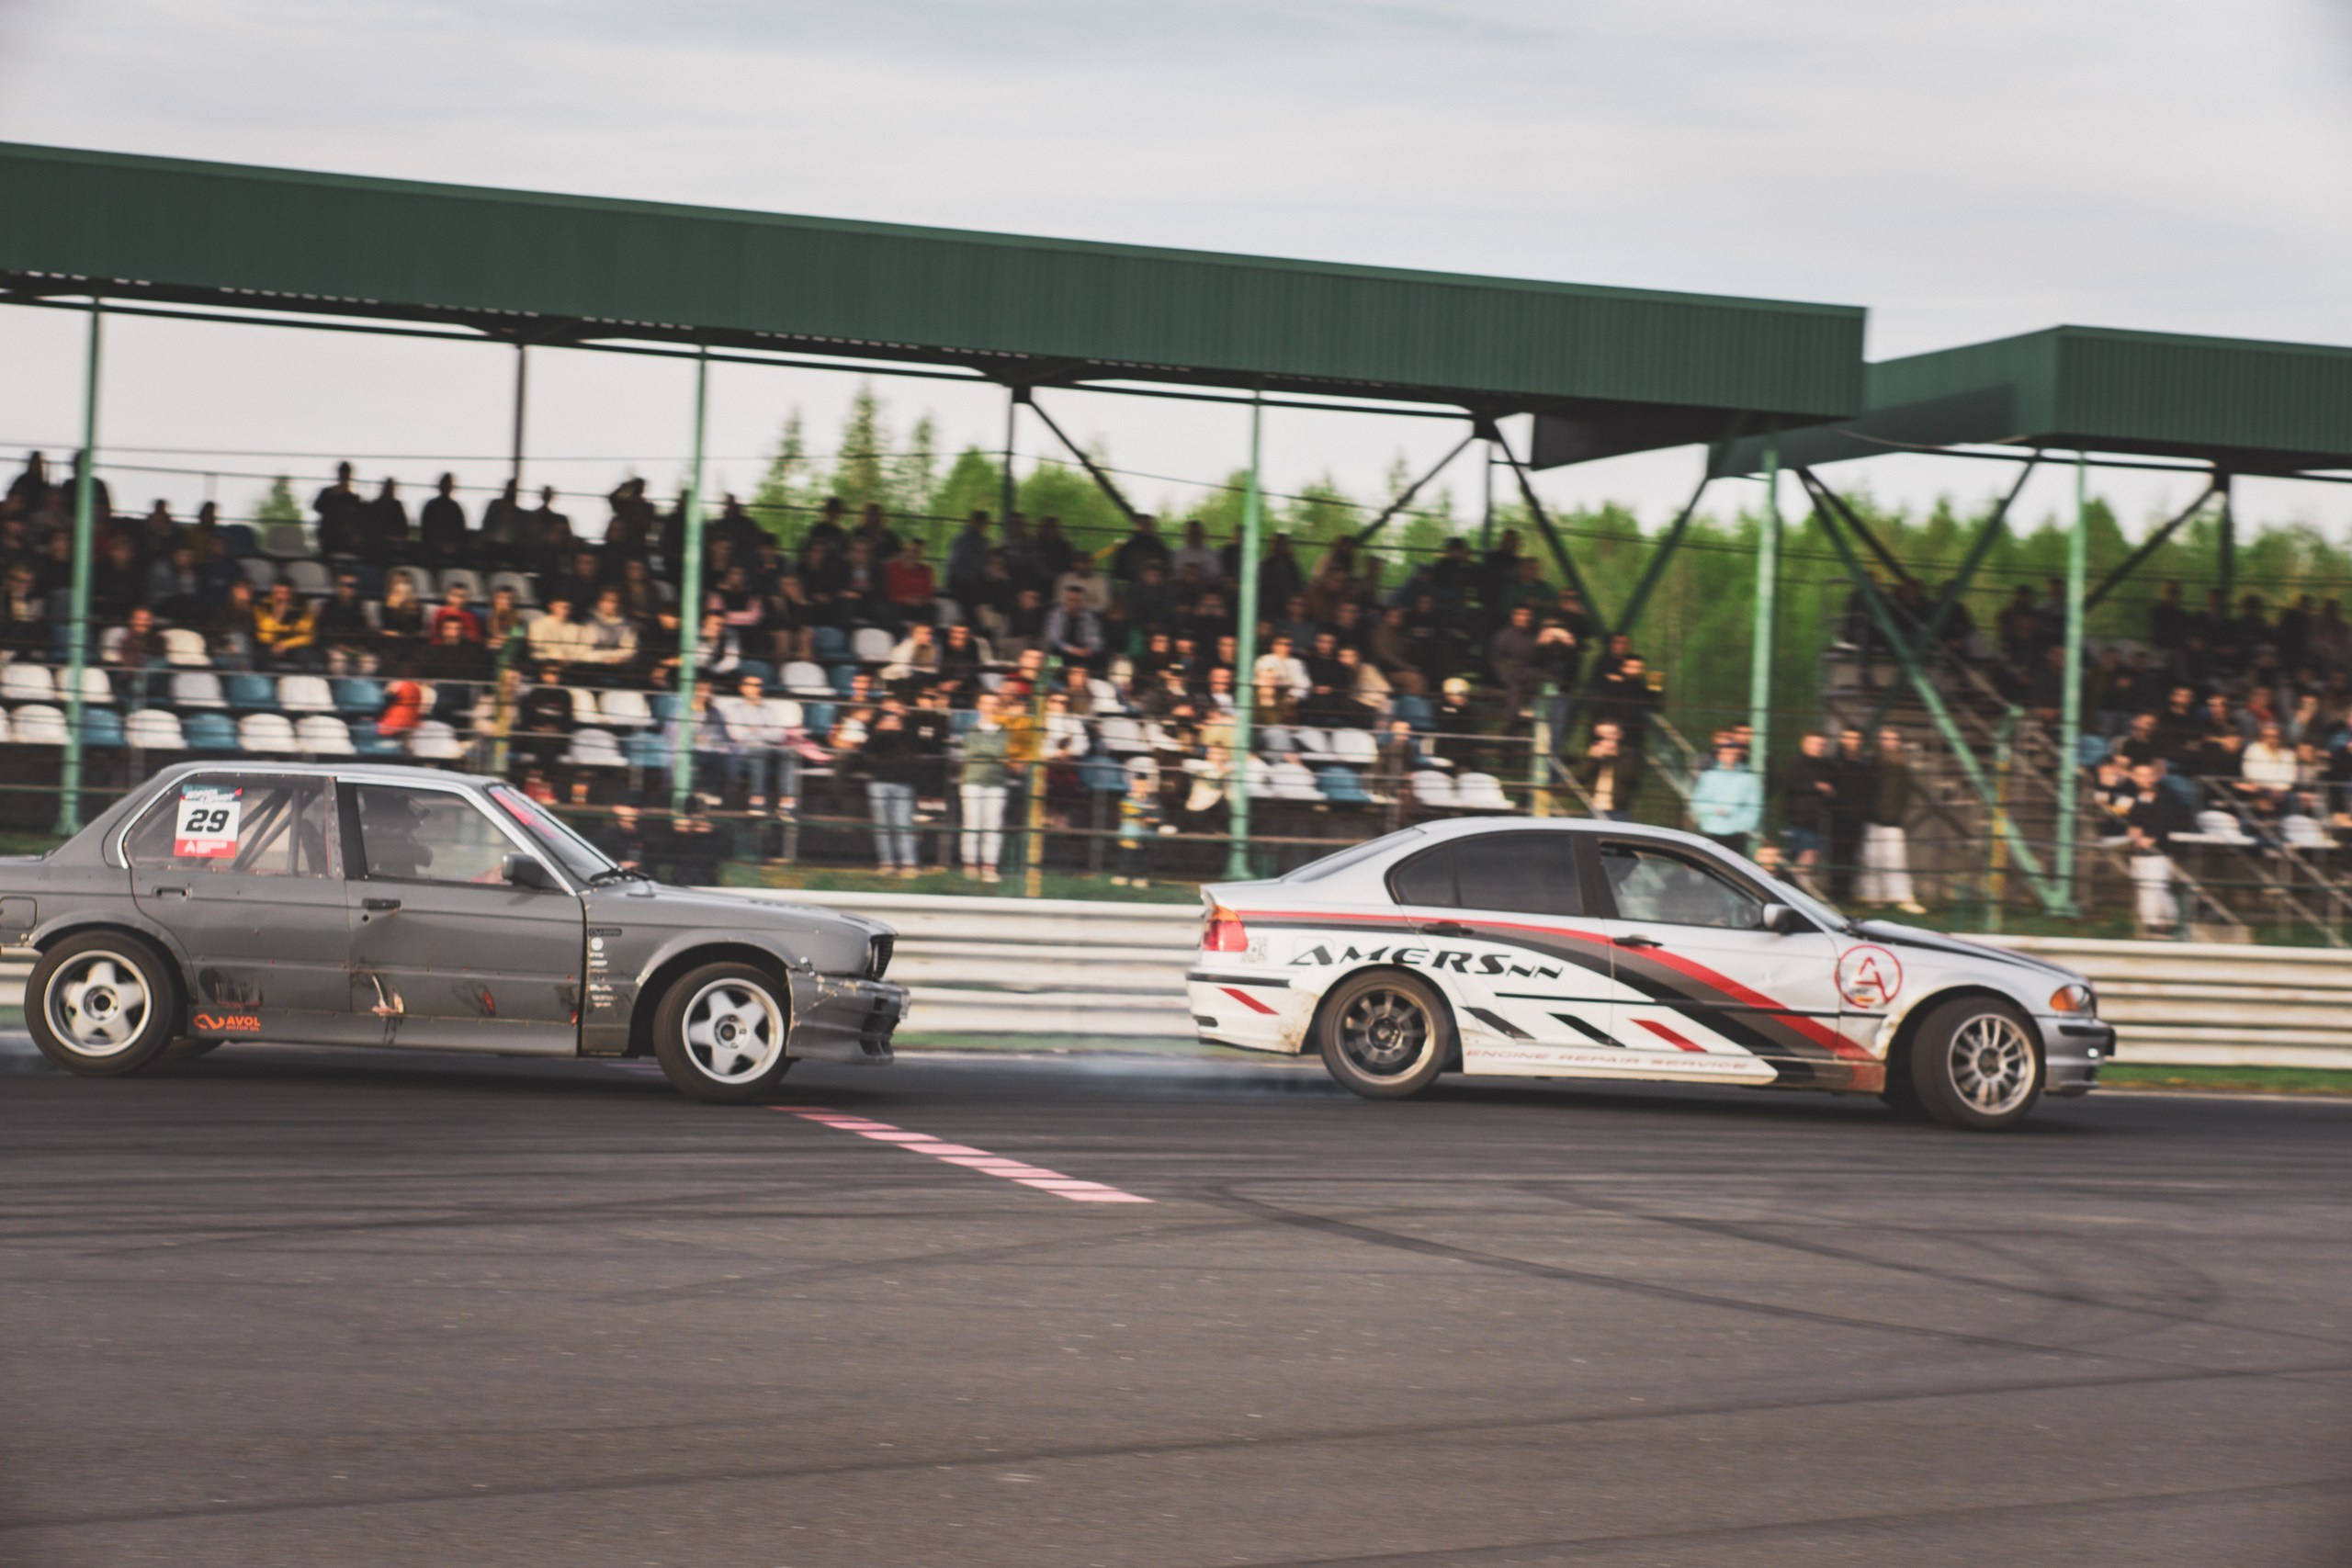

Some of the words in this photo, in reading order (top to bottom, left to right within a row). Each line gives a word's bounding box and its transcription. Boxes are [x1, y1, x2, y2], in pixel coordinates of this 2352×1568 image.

[185, 809, 230, 832] 29
[226, 1015, 261, 1027] AVOL
[1466, 1049, 1548, 1060] ENGINE
[1558, 1054, 1640, 1065] REPAIR
[1650, 1058, 1748, 1070] SERVICE
